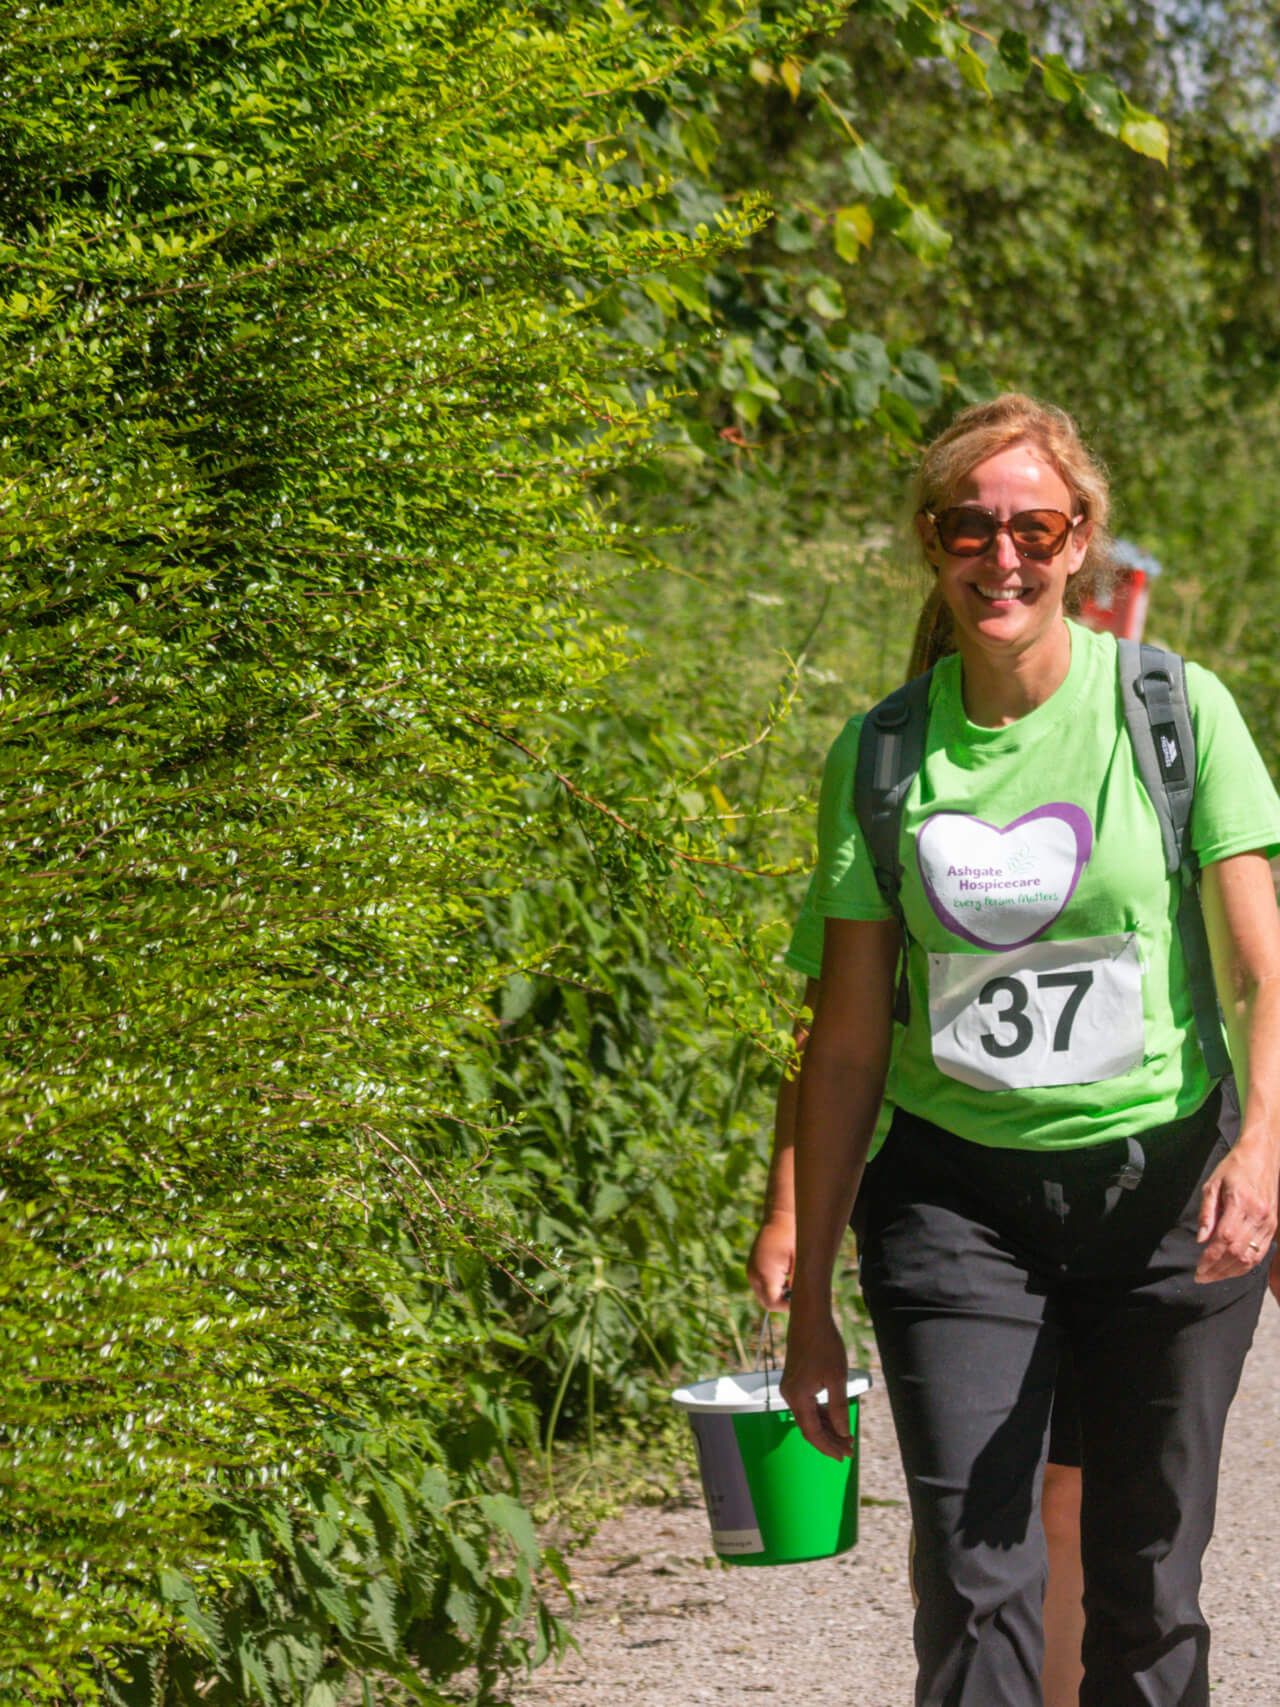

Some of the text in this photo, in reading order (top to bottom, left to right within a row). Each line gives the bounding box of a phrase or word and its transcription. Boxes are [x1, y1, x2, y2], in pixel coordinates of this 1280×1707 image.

[947, 866, 1003, 879] Ashgate
[959, 878, 1041, 892] Hospicecare
[978, 970, 1093, 1058] 37
